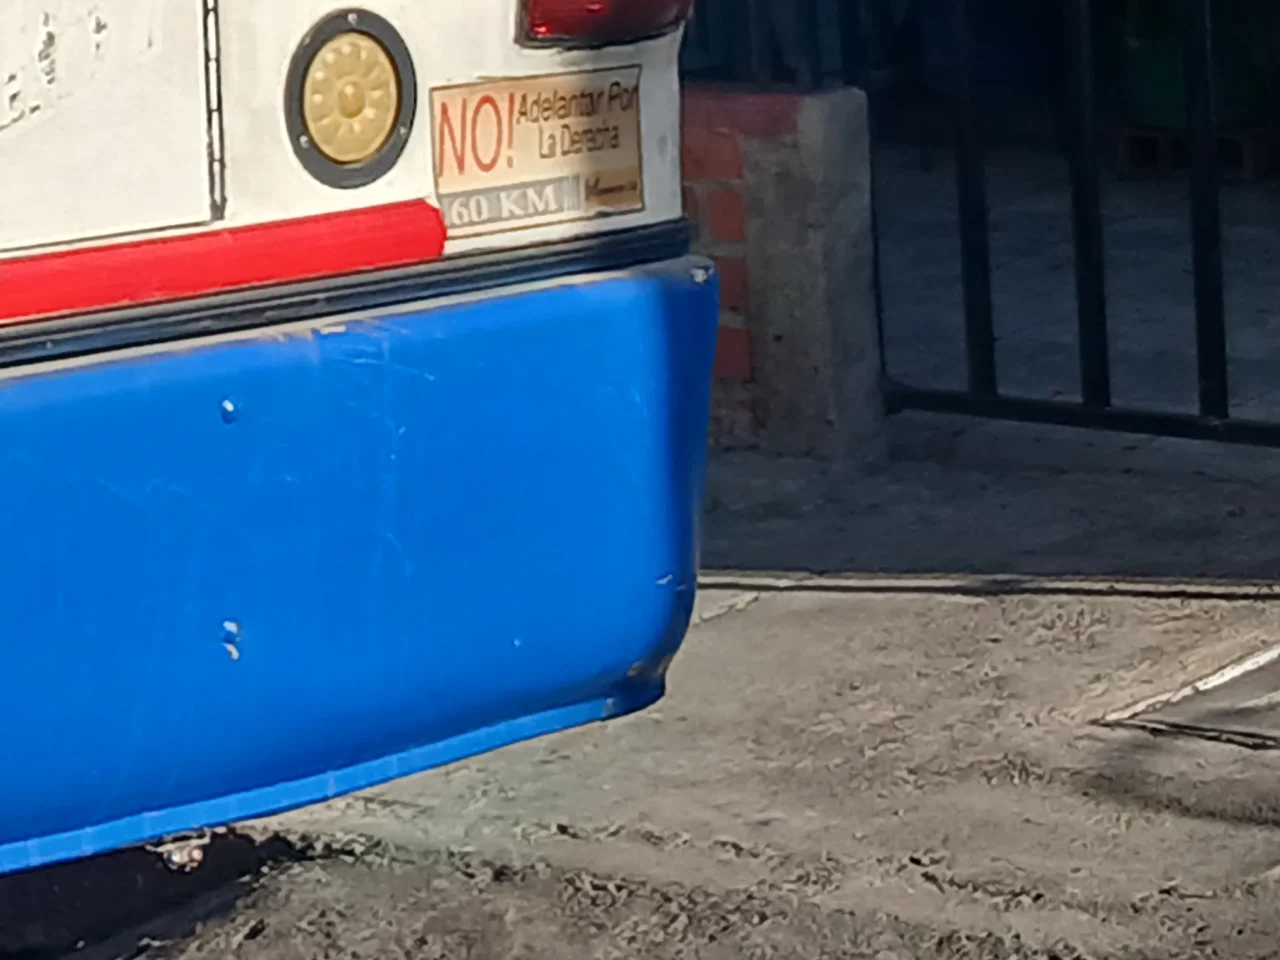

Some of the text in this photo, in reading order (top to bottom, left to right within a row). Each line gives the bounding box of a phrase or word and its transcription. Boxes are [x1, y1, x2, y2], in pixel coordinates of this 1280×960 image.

[516, 81, 639, 126] Adelantar Por
[438, 92, 516, 178] NO!
[538, 121, 620, 160] La Derecha
[451, 194, 490, 226] 60
[500, 183, 559, 218] KM
